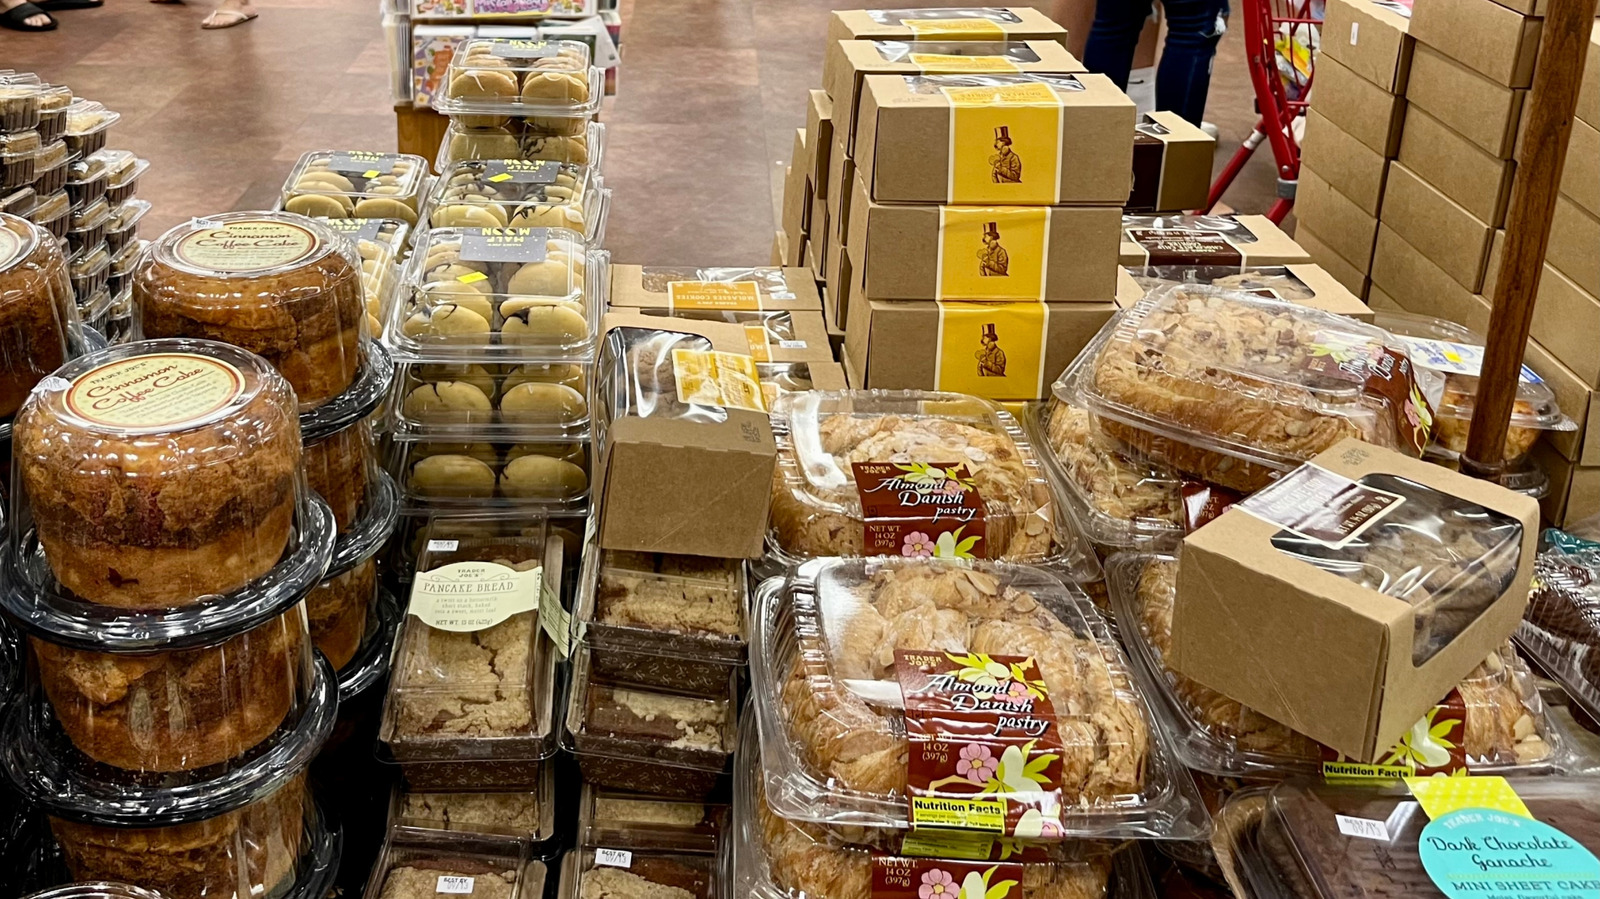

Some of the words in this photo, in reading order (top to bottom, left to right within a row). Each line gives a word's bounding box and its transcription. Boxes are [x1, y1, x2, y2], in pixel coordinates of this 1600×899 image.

[210, 231, 291, 240] Cinnamon
[481, 227, 531, 236] MOON
[195, 239, 252, 250] Coffee
[254, 239, 301, 248] Cake
[87, 364, 178, 398] Cinnamon
[90, 371, 122, 385] TRADER
[92, 386, 156, 410] Coffee
[153, 367, 204, 388] Cake
[864, 477, 946, 493] Almond
[898, 489, 964, 506] Danish
[932, 506, 977, 524] pastry
[869, 525, 886, 533] NET
[874, 539, 896, 548] (397g)
[423, 582, 472, 593] PANCAKE
[476, 581, 514, 592] BREAD
[904, 654, 942, 663] TRADER
[909, 674, 1010, 694] Almond
[951, 692, 1033, 713] Danish
[994, 715, 1049, 736] pastry
[933, 743, 949, 751] OZ
[922, 751, 948, 763] (397g)
[1325, 764, 1374, 776] Nutrition
[1377, 767, 1409, 778] Facts
[914, 800, 965, 812] Nutrition
[968, 803, 1002, 815] Facts
[1344, 818, 1364, 826] BEST
[1442, 813, 1484, 830] TRADER
[1487, 813, 1521, 828] JOE'S
[1426, 836, 1481, 851] Dark
[1482, 835, 1574, 850] Chocolate
[878, 856, 898, 867] NET
[1471, 853, 1553, 871] Ganache
[886, 868, 894, 876] 14
[896, 868, 911, 877] OZ
[885, 876, 910, 887] (397g)
[1452, 881, 1493, 891] MINI
[1495, 881, 1552, 891] SHEET
[1557, 880, 1600, 891] CAKE
